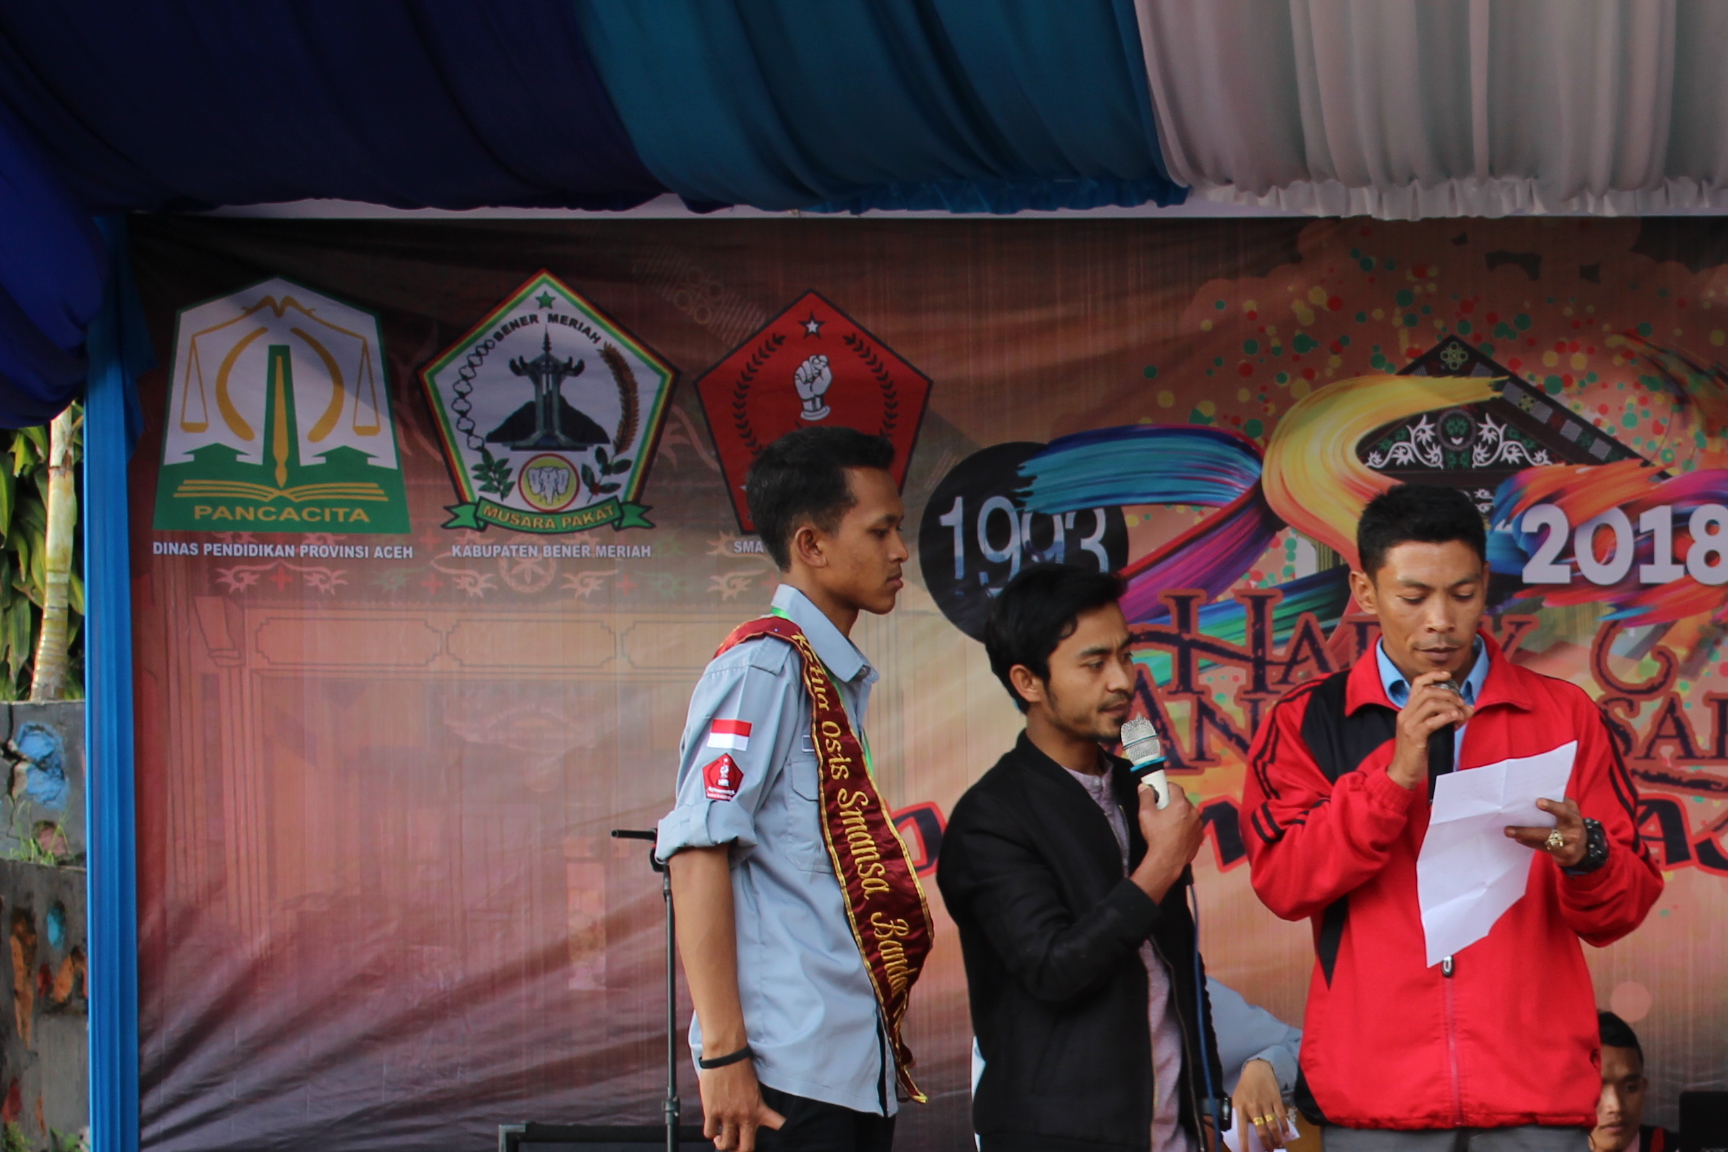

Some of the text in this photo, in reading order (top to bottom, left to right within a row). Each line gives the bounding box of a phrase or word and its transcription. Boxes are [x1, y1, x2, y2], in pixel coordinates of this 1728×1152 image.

[493, 313, 602, 344] BENER MERIAH
[193, 505, 371, 523] PANCACITA
[482, 504, 616, 530] MUSARA PAKAT
[152, 541, 414, 559] DINAS PENDIDIKAN PROVINSI ACEH
[451, 544, 652, 559] KABUPATEN BENER MERIAH
[733, 540, 765, 554] SMA
[821, 720, 852, 780] Osis
[837, 789, 891, 901] Smansa
